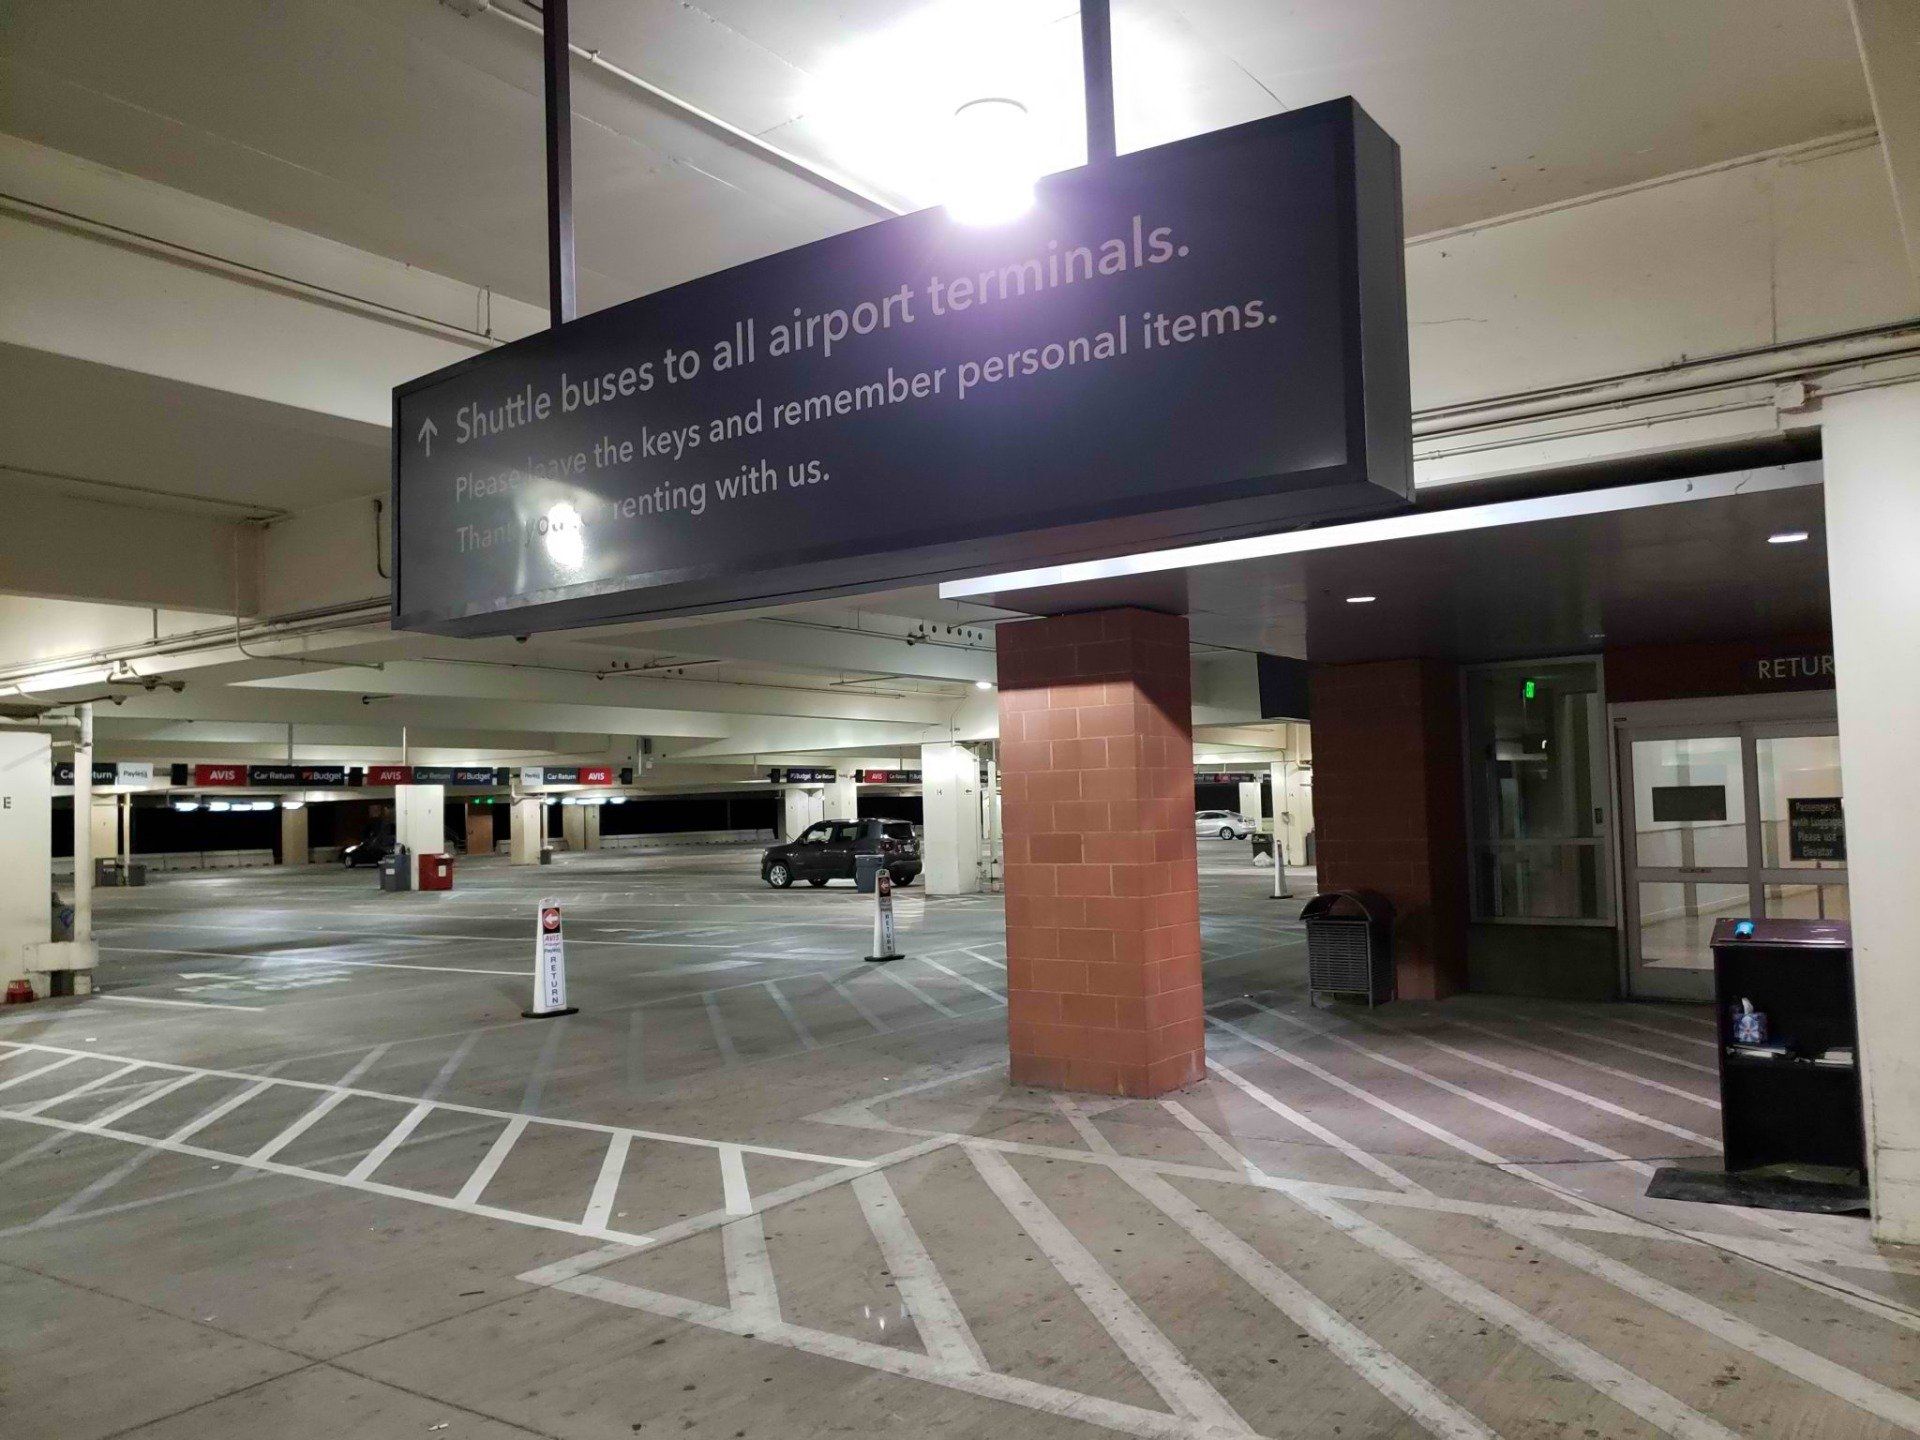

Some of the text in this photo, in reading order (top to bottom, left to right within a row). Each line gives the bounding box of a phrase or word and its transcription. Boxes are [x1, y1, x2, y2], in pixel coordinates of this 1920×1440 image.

[456, 214, 1190, 444] Shuttle buses to all airport terminals.
[456, 300, 1278, 501] Please leave the keys and remember personal items.
[456, 519, 514, 552] Than
[612, 481, 706, 520] renting
[715, 459, 778, 501] with
[788, 459, 830, 488] us.
[1758, 654, 1835, 679] RETUR
[60, 769, 113, 779] Ca turn
[209, 770, 236, 781] AVIS
[254, 771, 296, 780] Car Return
[313, 772, 342, 782] Budget
[380, 772, 402, 780] AVIS
[467, 773, 491, 782] Budget
[588, 772, 605, 780] AVIS
[3, 796, 11, 809] E
[550, 956, 559, 1004] RETURN
